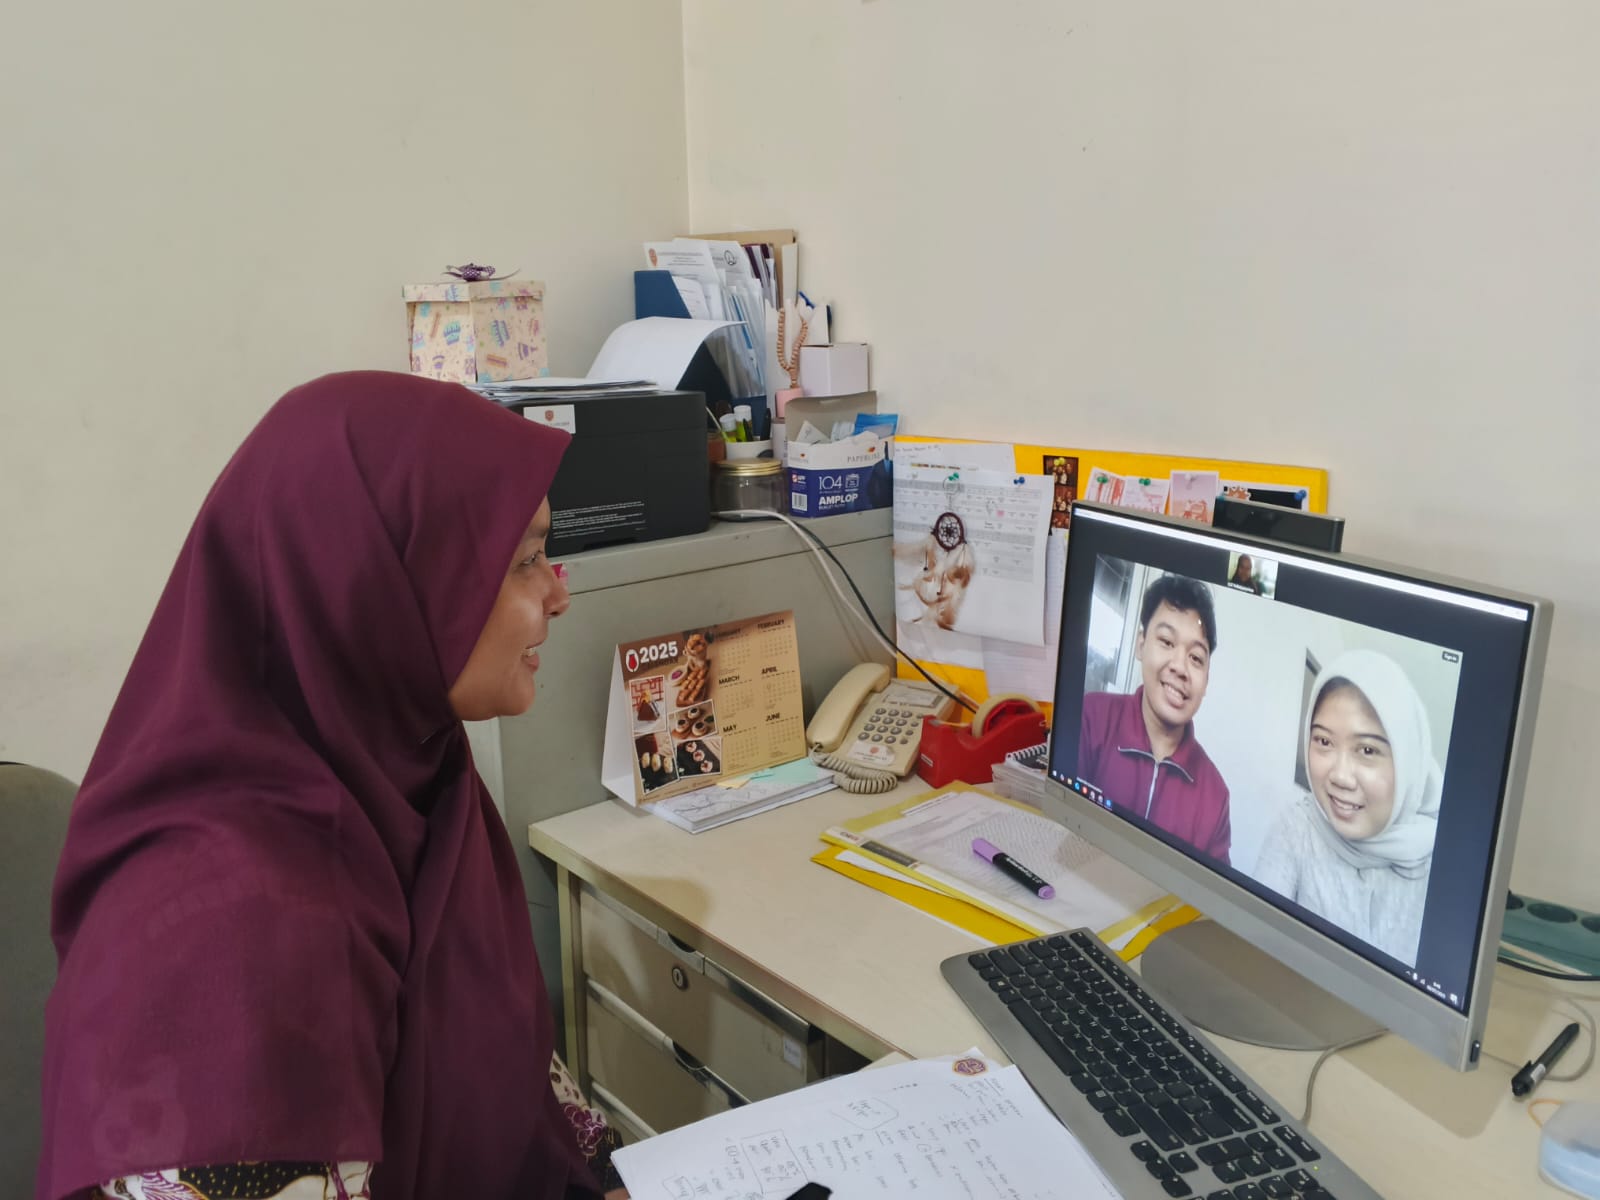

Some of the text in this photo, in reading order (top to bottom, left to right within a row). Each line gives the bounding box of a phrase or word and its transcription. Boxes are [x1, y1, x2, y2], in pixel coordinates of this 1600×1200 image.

[819, 474, 842, 490] 104
[818, 493, 859, 506] AMPLOP
[639, 640, 678, 664] 2025
[761, 666, 778, 675] APRIL
[718, 674, 740, 685] MARCH
[765, 712, 780, 722] JUNE
[722, 724, 737, 733] MAY
